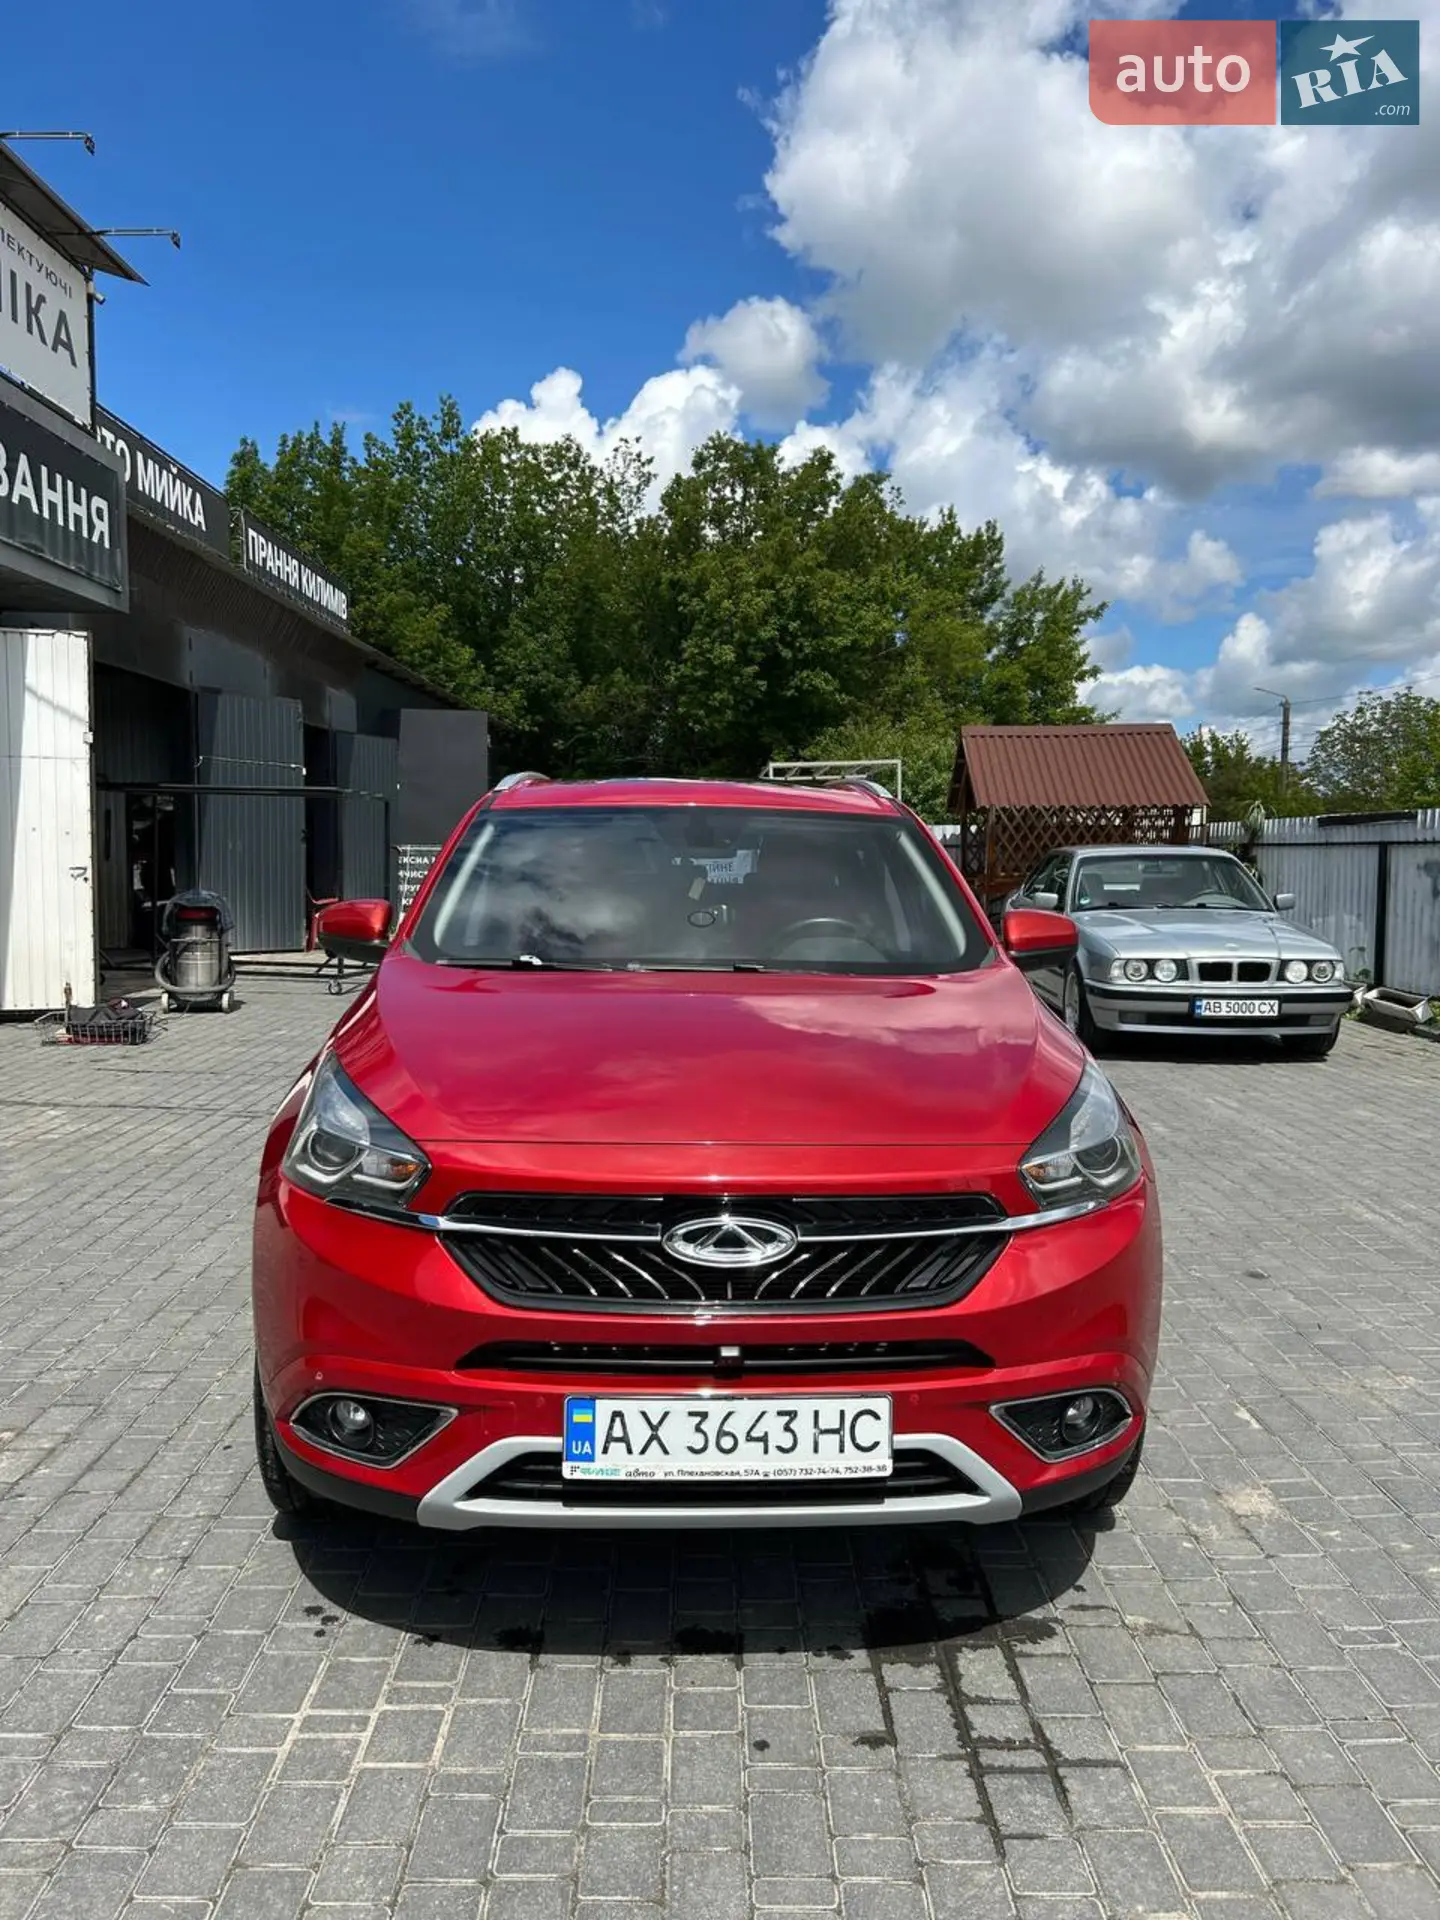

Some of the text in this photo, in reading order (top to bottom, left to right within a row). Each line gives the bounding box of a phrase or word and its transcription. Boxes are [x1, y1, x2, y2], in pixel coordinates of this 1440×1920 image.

[0, 260, 77, 368] ІКА
[136, 450, 207, 532] МИЙКА
[248, 527, 348, 620] ПРАННЯ КИЛИМІВ
[1203, 1001, 1276, 1015] AB 5000 CX
[572, 1440, 592, 1454] UA
[600, 1408, 882, 1455] AX 3643 HC
